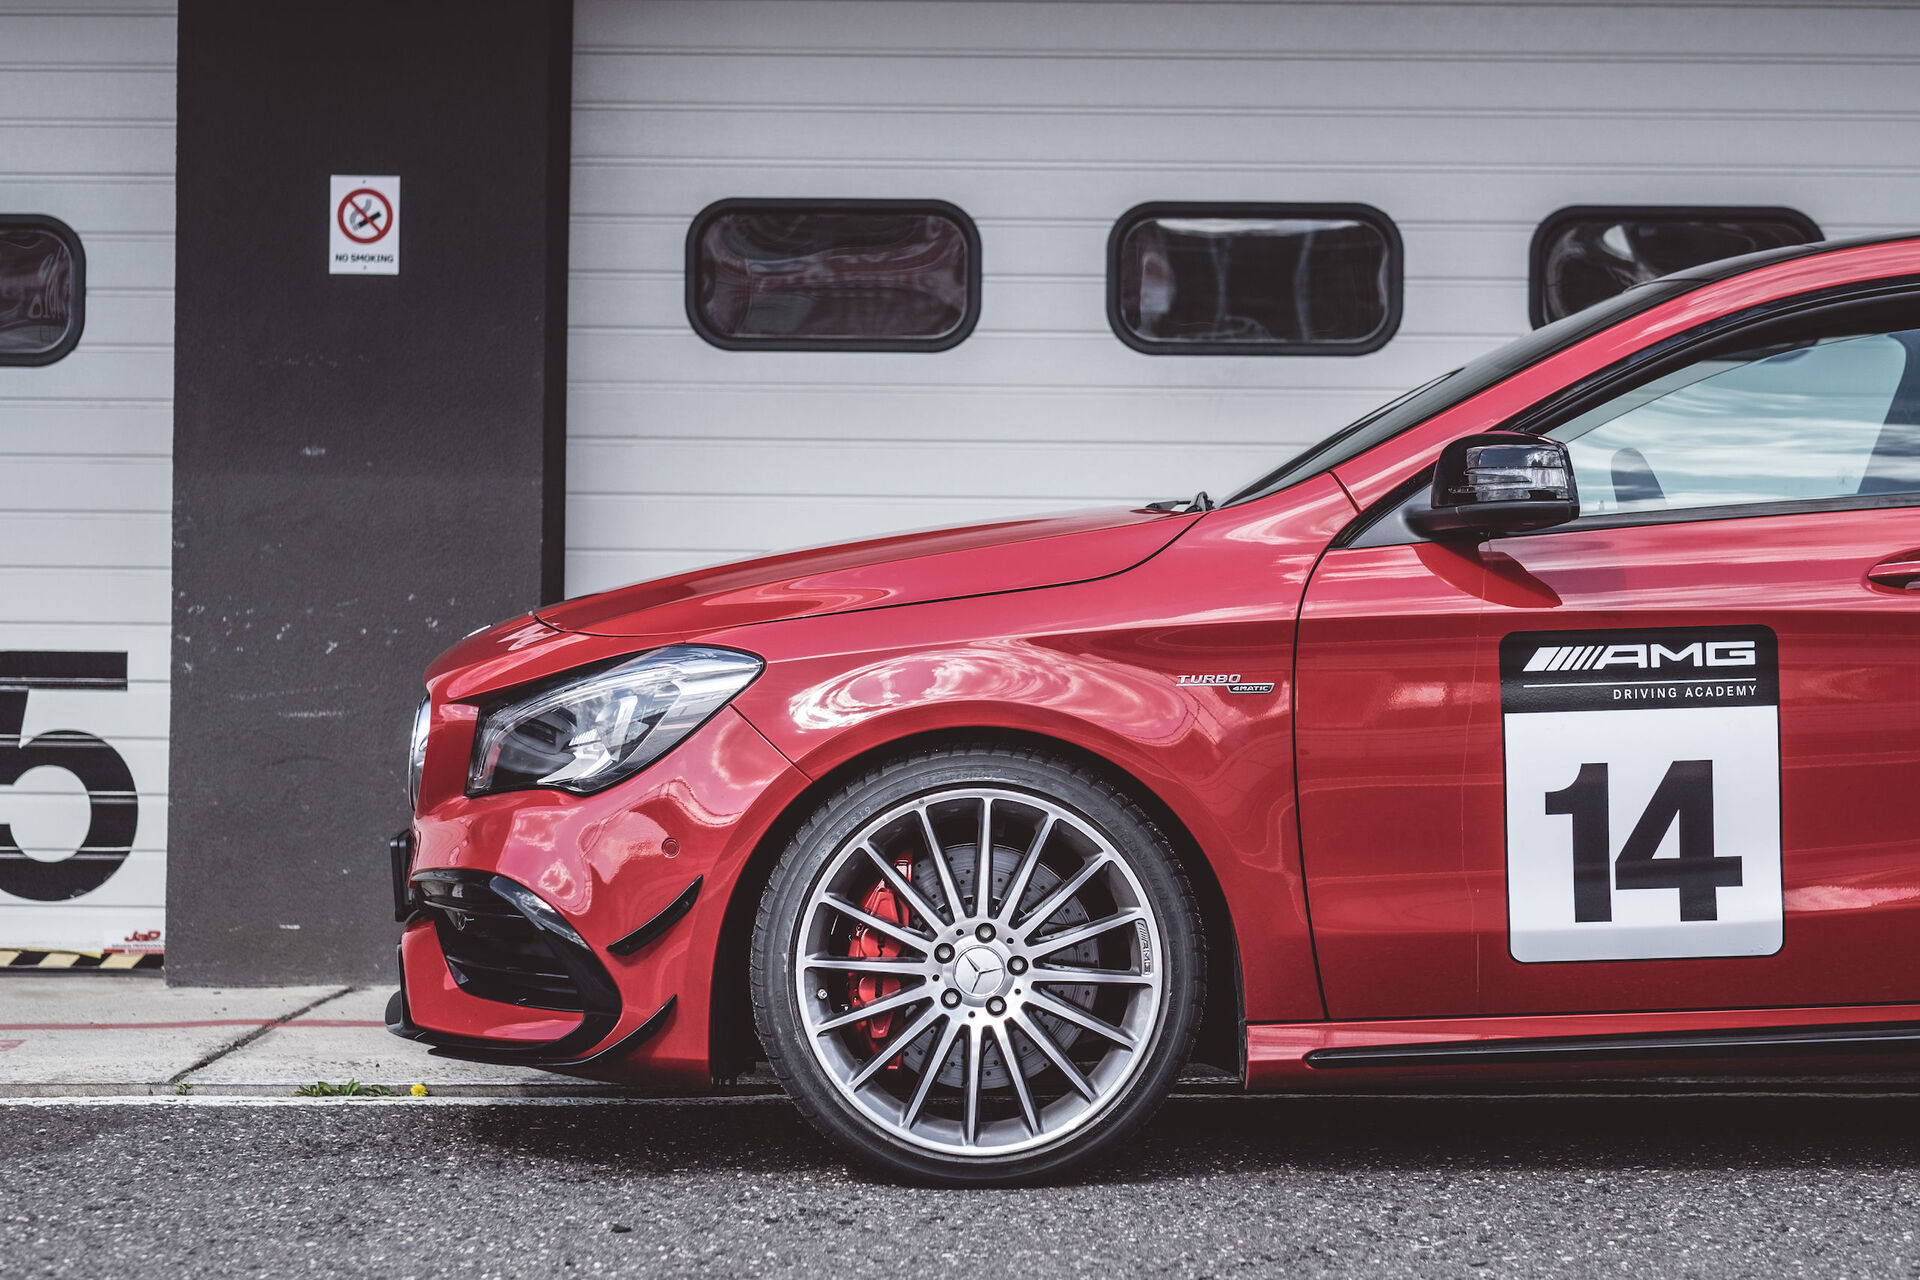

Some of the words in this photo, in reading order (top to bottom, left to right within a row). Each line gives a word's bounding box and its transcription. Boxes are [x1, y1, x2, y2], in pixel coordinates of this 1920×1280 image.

[335, 253, 349, 263] NO
[351, 253, 394, 263] SMOKING
[1592, 641, 1756, 669] AMG
[1177, 674, 1242, 684] TURBO
[1613, 687, 1677, 700] DRIVING
[1685, 685, 1757, 698] ACADEMY
[0, 650, 139, 901] 5
[1545, 759, 1743, 923] 14
